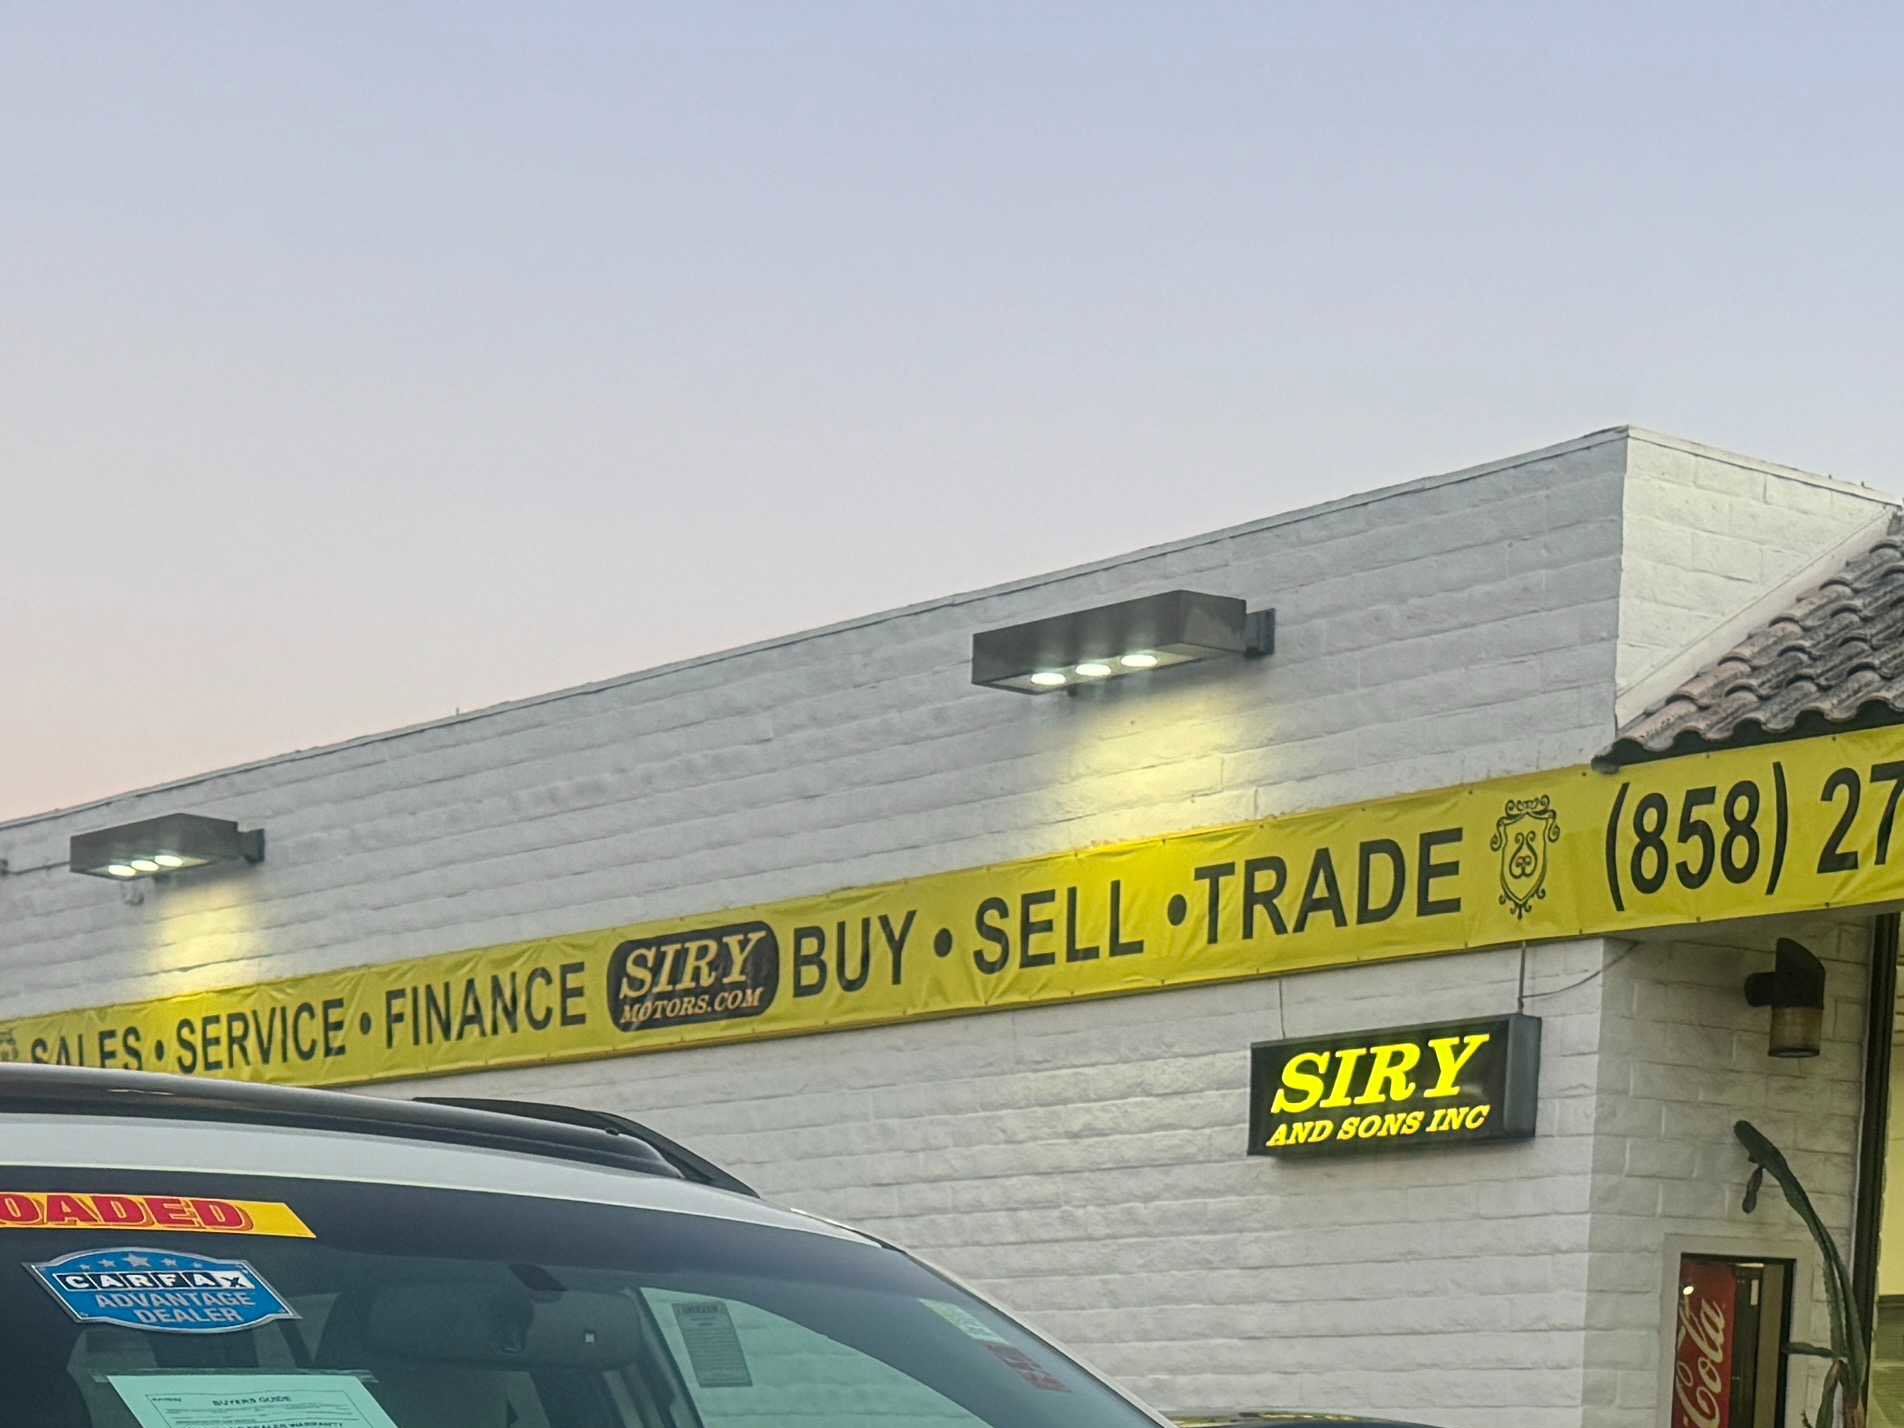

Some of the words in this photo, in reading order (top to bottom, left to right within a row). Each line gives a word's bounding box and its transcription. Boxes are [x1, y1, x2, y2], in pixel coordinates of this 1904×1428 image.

[1605, 760, 1788, 912] (858)
[792, 909, 917, 998] BUY
[973, 878, 1143, 976] SELL
[1193, 827, 1464, 945] TRADE
[619, 931, 767, 999] SIRY
[176, 998, 346, 1074] SERVICE
[385, 962, 586, 1050] FINANCE
[620, 987, 764, 1023] MOTORS.COM
[1270, 1033, 1490, 1113] SIRY
[1266, 1119, 1333, 1147] AND
[1337, 1111, 1425, 1140] SONS
[1426, 1105, 1490, 1133] INC
[60, 1272, 256, 1290] CARFAX
[94, 1292, 256, 1310] ADVANTAGE
[133, 1307, 245, 1325] DEALER
